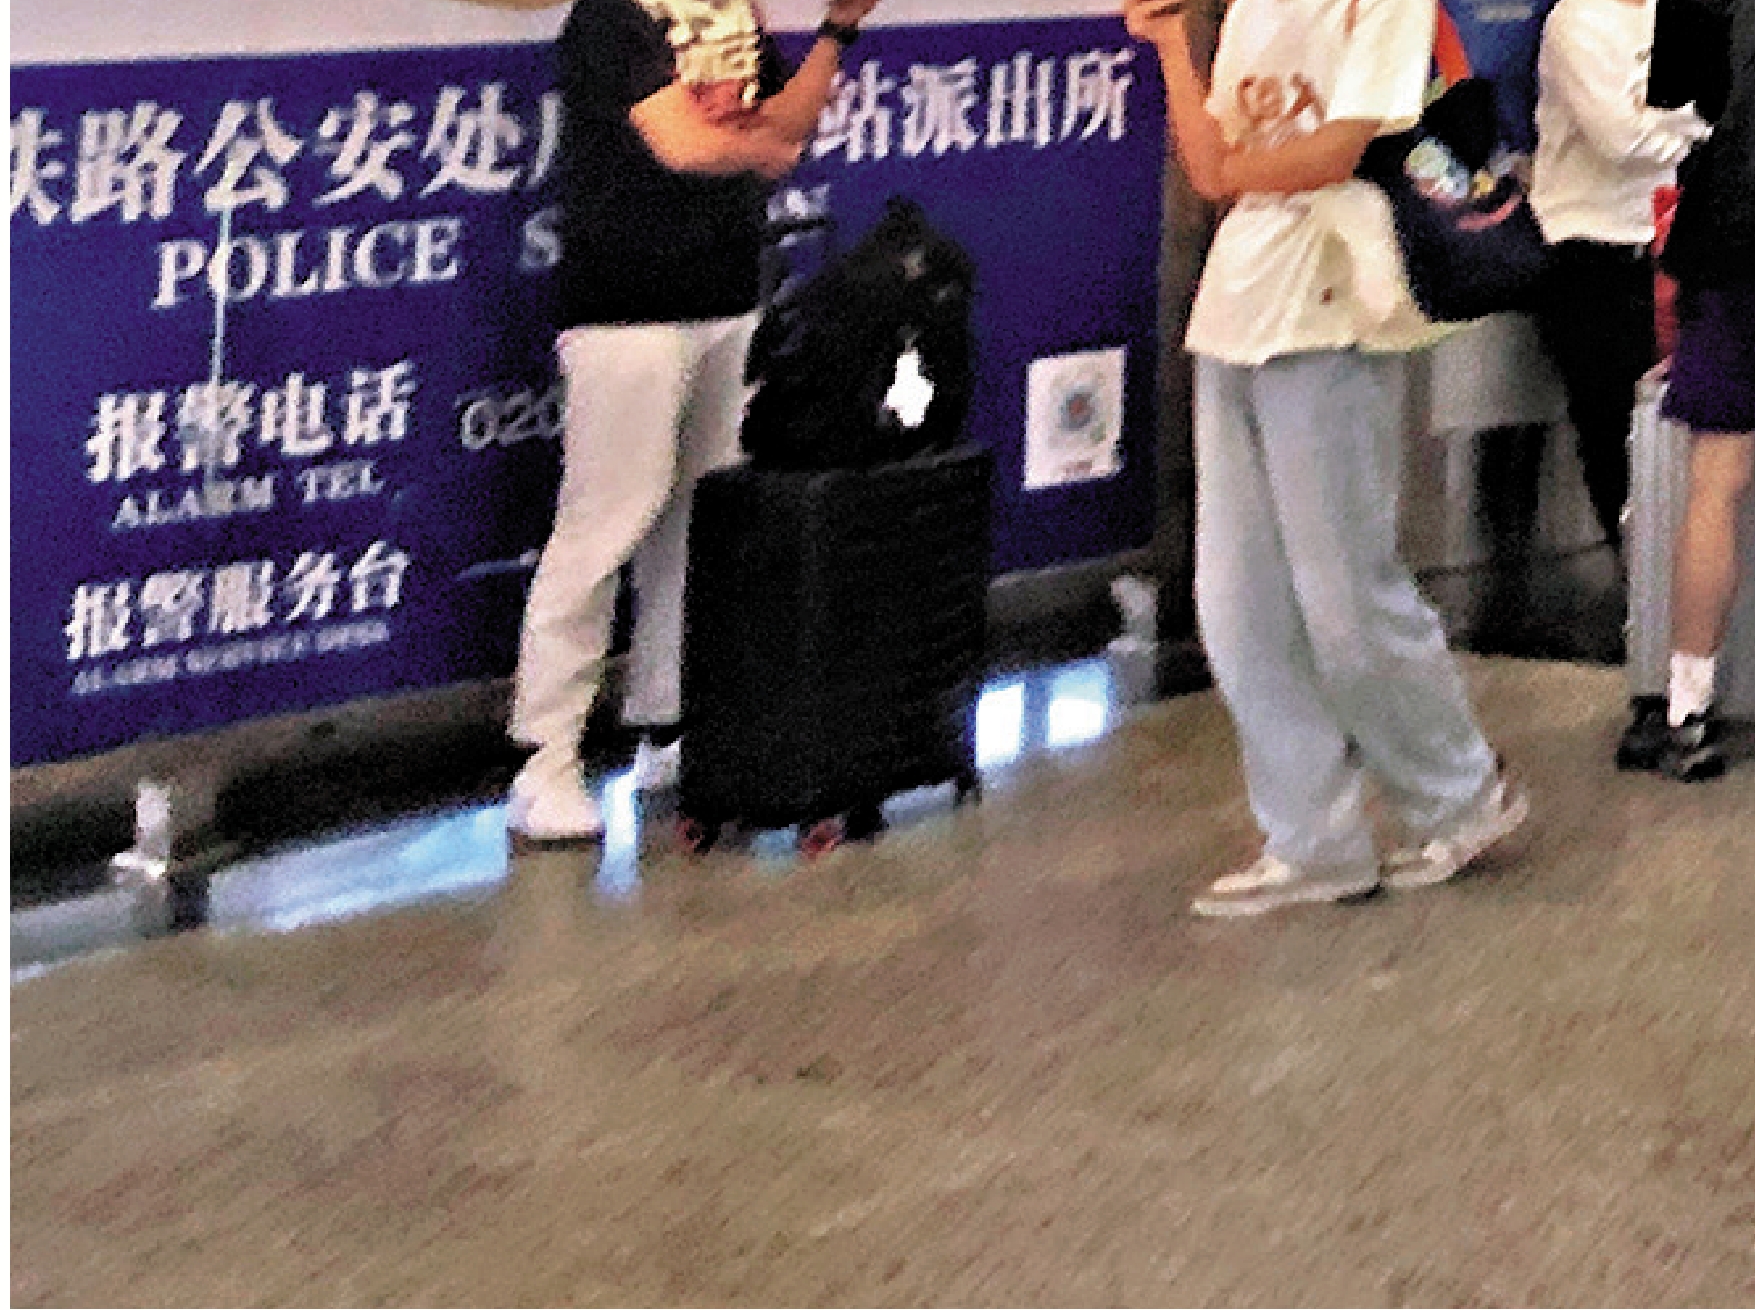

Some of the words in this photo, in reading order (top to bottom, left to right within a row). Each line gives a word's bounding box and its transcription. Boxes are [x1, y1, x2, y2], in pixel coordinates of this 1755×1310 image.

[150, 217, 463, 310] POLICE
[86, 359, 417, 483] 报警电话
[111, 472, 276, 532] ALARM
[297, 459, 386, 504] TEL
[64, 539, 412, 663] 报警服务台
